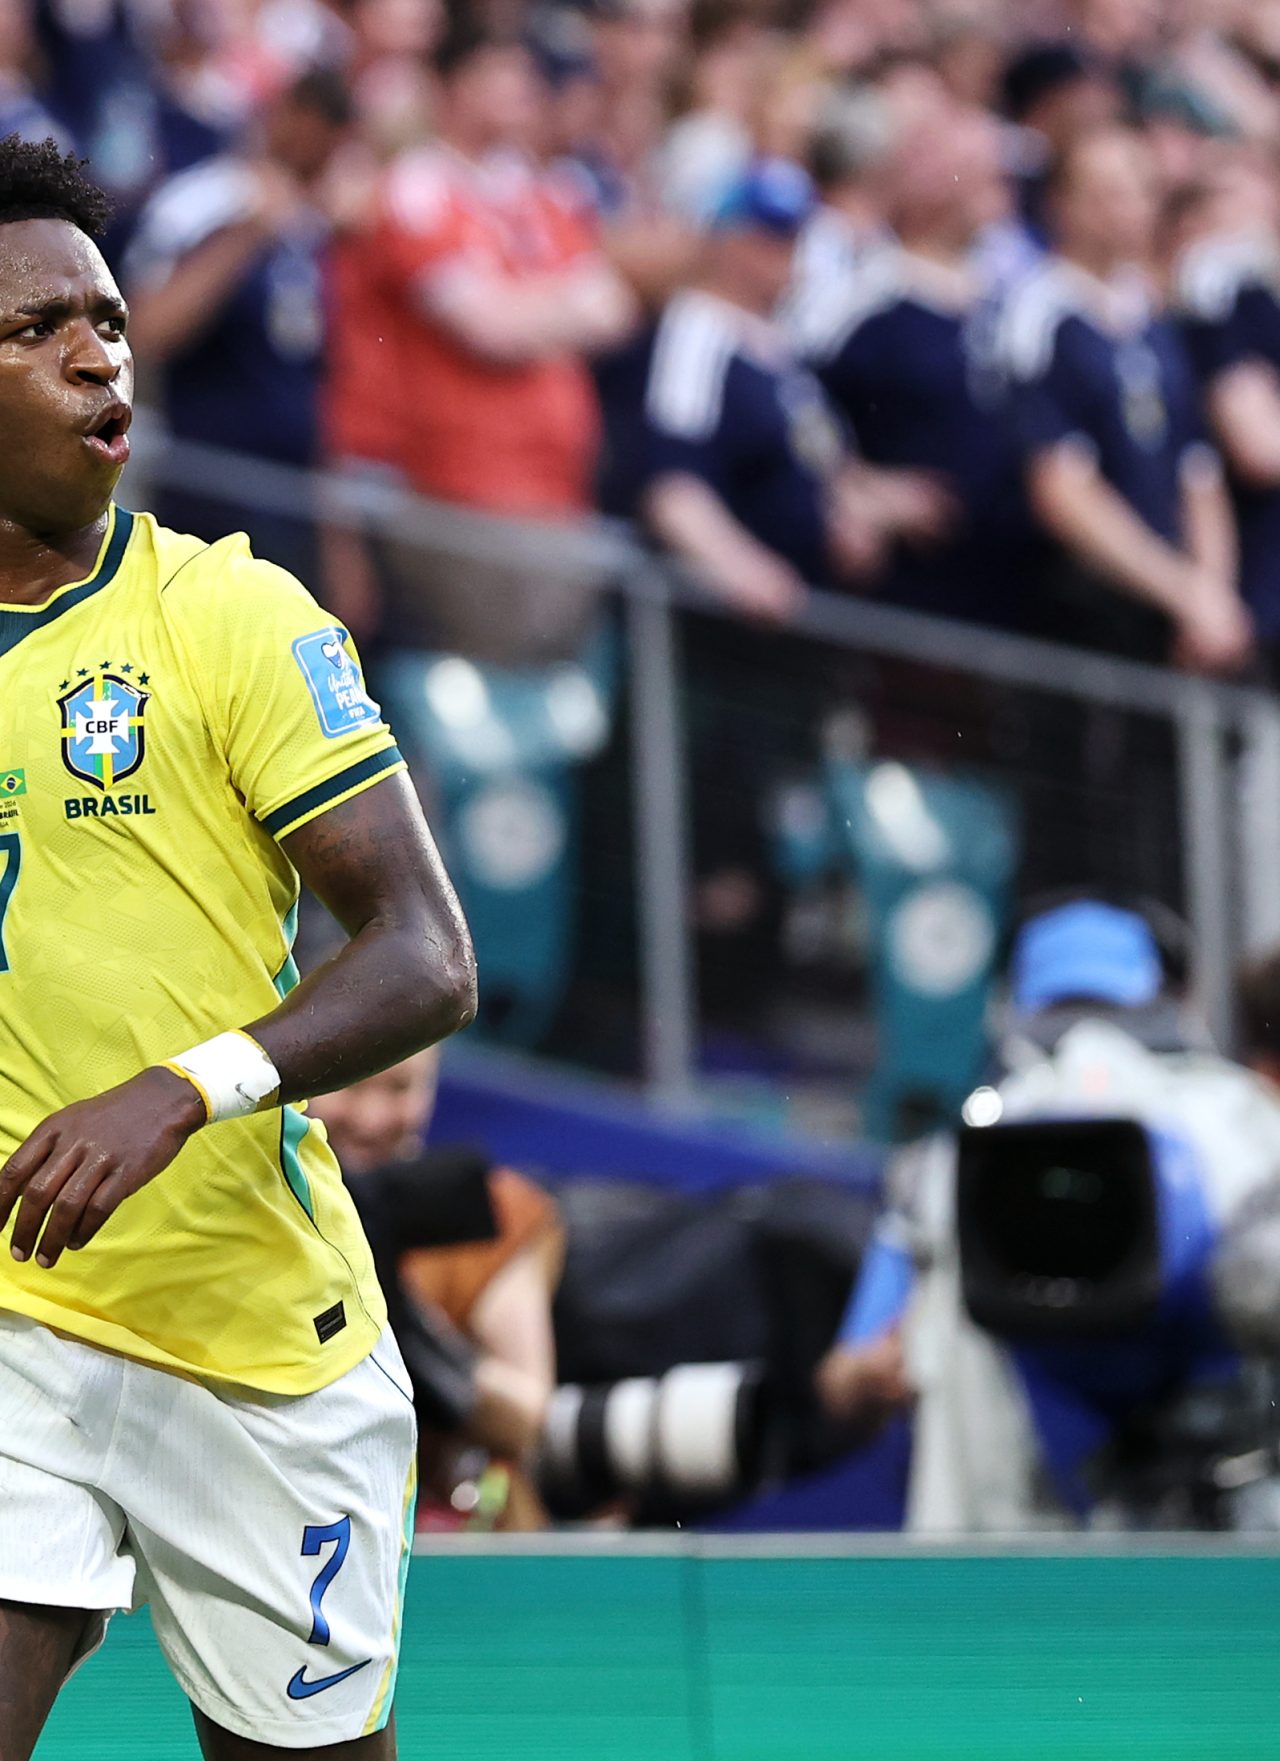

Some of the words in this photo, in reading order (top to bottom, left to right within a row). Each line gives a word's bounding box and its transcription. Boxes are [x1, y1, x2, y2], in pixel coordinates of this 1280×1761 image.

[85, 719, 119, 734] CBF
[64, 794, 157, 819] BRASIL
[300, 1514, 351, 1647] 7
